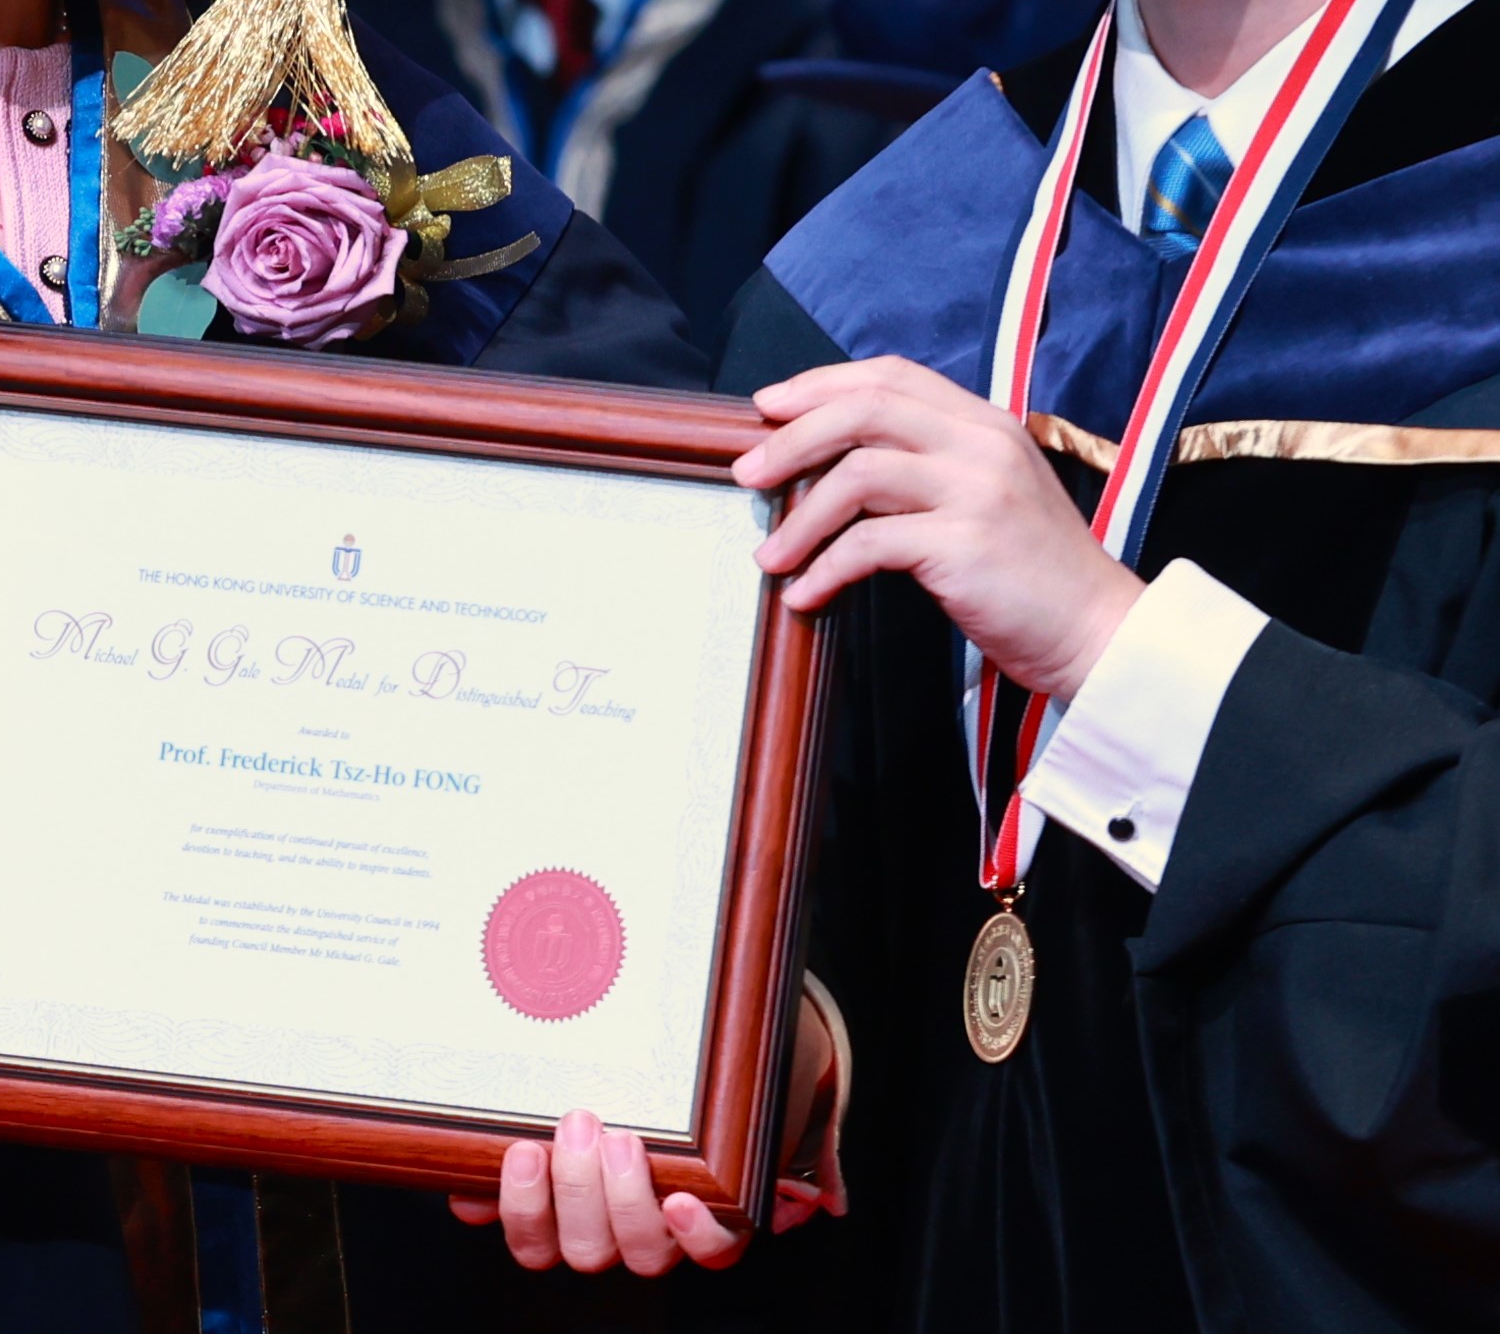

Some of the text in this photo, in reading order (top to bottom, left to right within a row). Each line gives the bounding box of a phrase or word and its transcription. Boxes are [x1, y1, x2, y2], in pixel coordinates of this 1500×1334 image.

[139, 569, 547, 624] THE HONG KONG UNIVERSITY OF SCIENCE AND TECHNOLOGY
[30, 609, 636, 722] Michael G. Gale Medal for Distinguished Teaching
[297, 726, 350, 739] Awarded to
[158, 742, 481, 795] Prof. Frederick Tsz-Ho FONG
[253, 780, 380, 802] Department of Mathematics
[190, 823, 430, 859] for exemplification of continued pursuit of excellence,
[182, 843, 220, 855] devotion
[223, 847, 232, 856] to
[278, 853, 296, 863] and
[299, 855, 314, 865] the
[315, 856, 345, 870] ability
[347, 860, 356, 869] to
[359, 862, 389, 875] inspire
[163, 892, 441, 930] The Medal was established by the University Council in 1994
[189, 934, 229, 949] founding
[232, 939, 267, 951] Council
[270, 943, 307, 956] Member
[309, 947, 323, 957] Mr
[326, 949, 360, 962] Michael
[199, 916, 398, 948] to commemorate the distinguished service of
